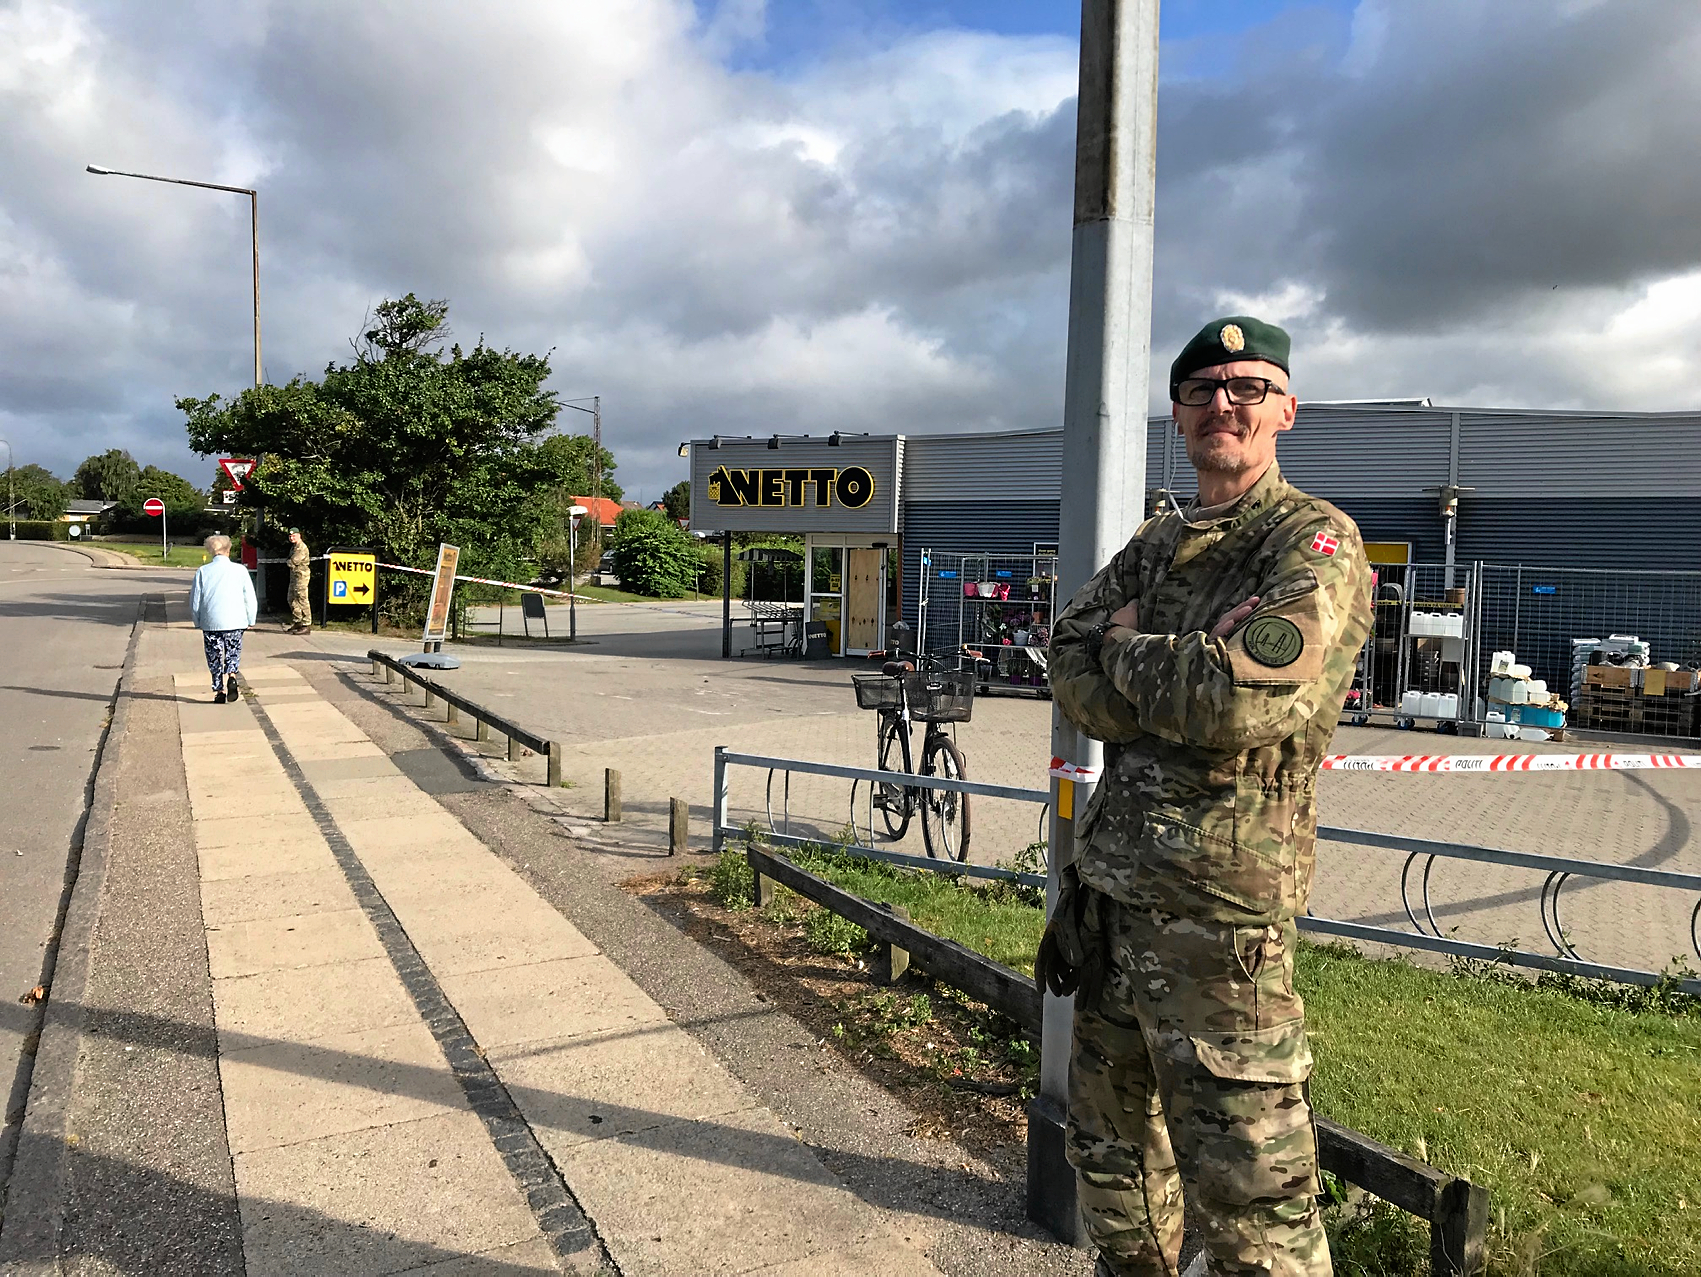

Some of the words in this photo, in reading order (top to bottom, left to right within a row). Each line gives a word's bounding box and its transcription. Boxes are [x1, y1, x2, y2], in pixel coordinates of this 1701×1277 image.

[711, 465, 875, 509] NETTO
[333, 561, 373, 573] NETTO
[335, 582, 345, 596] P
[1455, 759, 1483, 769] POLITI
